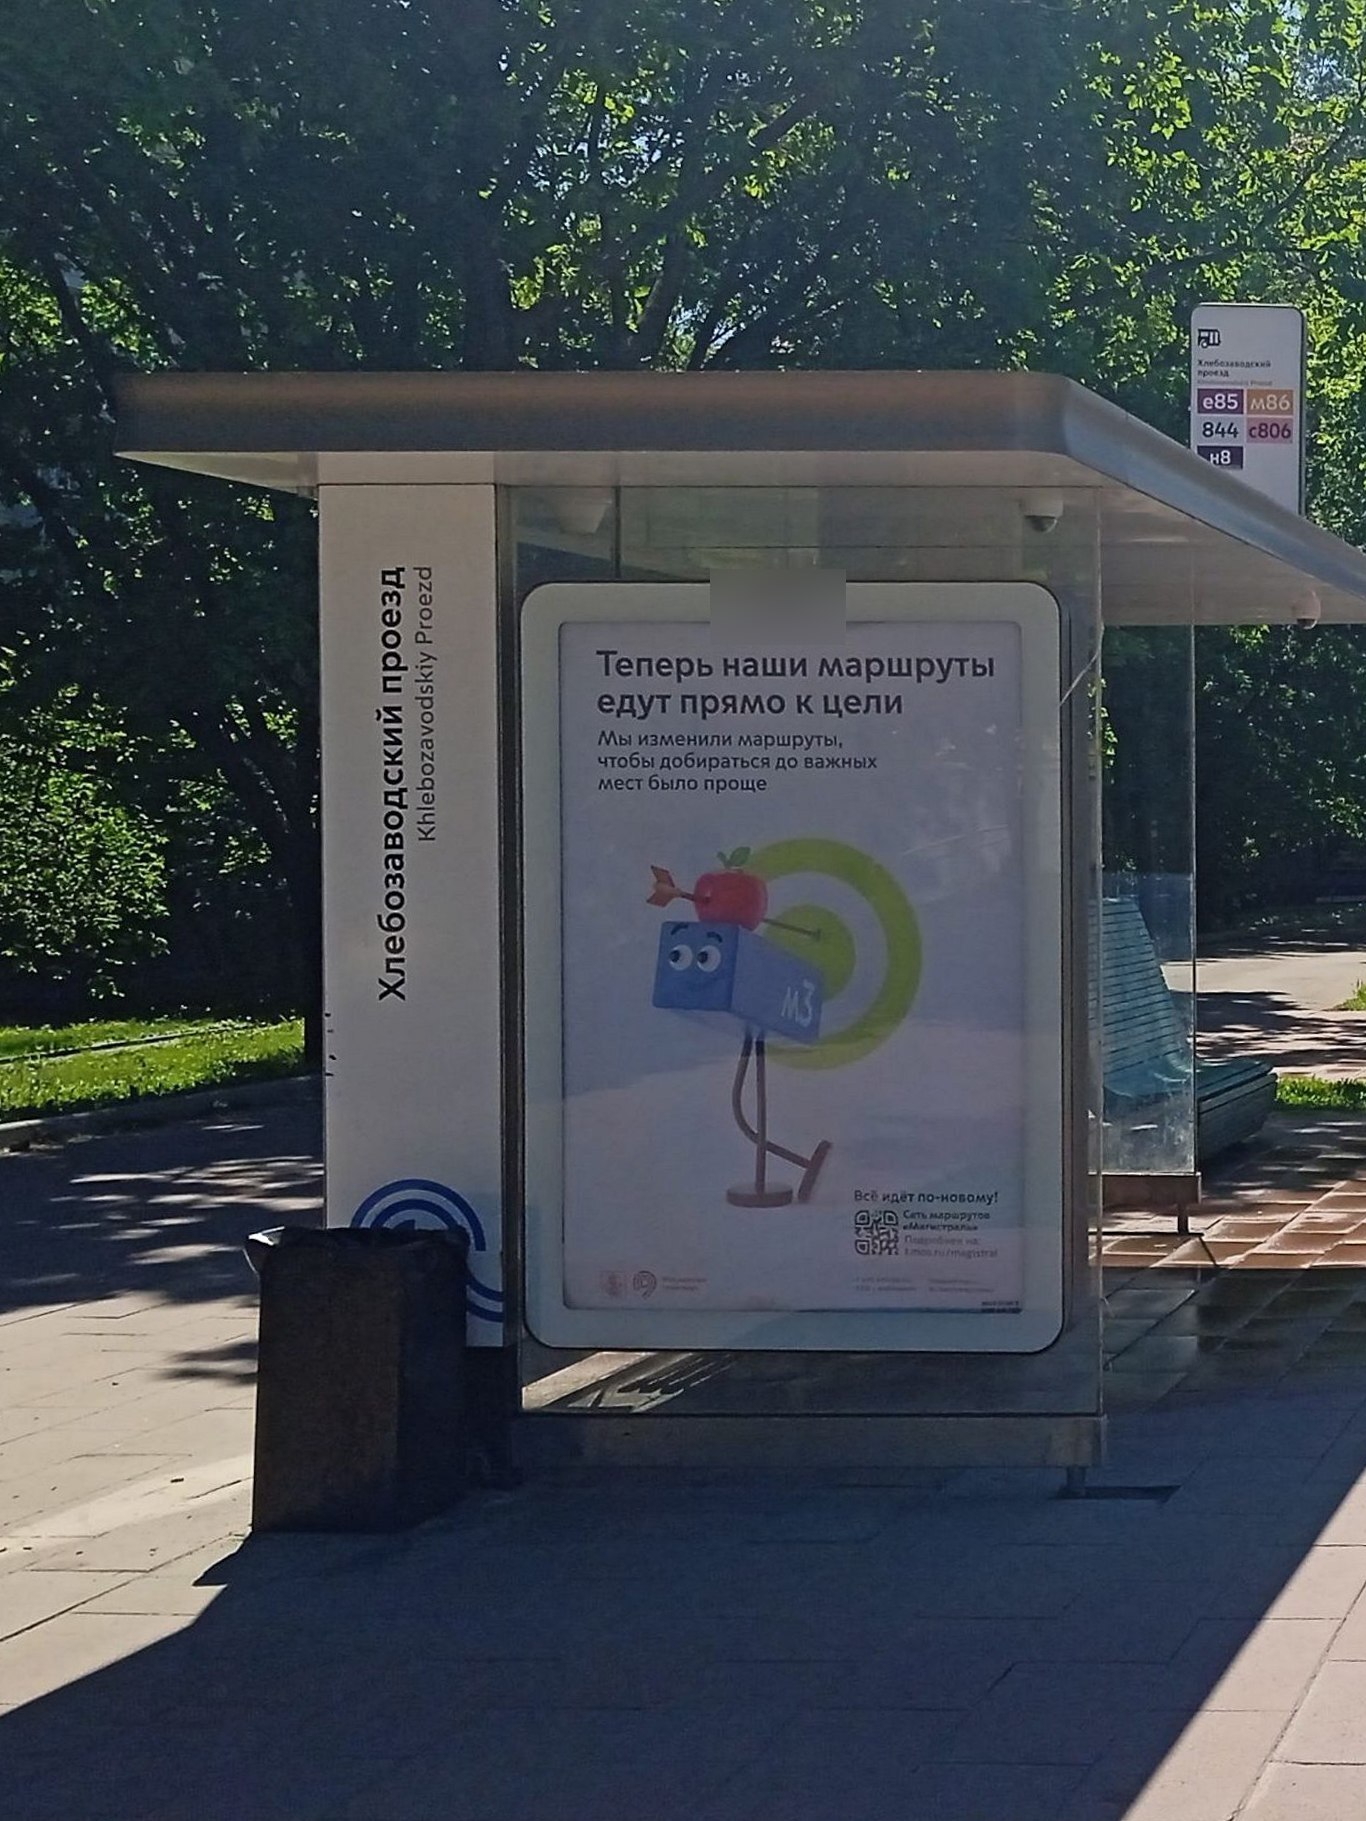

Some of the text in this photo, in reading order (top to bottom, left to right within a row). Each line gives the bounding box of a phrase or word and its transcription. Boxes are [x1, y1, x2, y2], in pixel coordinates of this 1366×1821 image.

[1197, 358, 1271, 368] Хлебозаводский
[1197, 369, 1229, 378] проезд
[1202, 393, 1238, 410] е85
[1250, 394, 1291, 410] м86
[1202, 422, 1239, 438] 844
[1249, 422, 1291, 439] с806
[596, 650, 995, 683] Теперь наши маршруты
[413, 566, 438, 842] Khlebozavodskiy Proezd
[598, 692, 903, 720] едут прямо к цели
[598, 730, 843, 751] Мы изменили маршруты,
[598, 753, 878, 773] чтобы добираться до важных
[376, 567, 408, 1001] Хлебозаводский проезд
[598, 774, 768, 796] мест было проще
[854, 1190, 999, 1206] Всё идёт по-новому!
[903, 1210, 991, 1222] Сеть маршрутов
